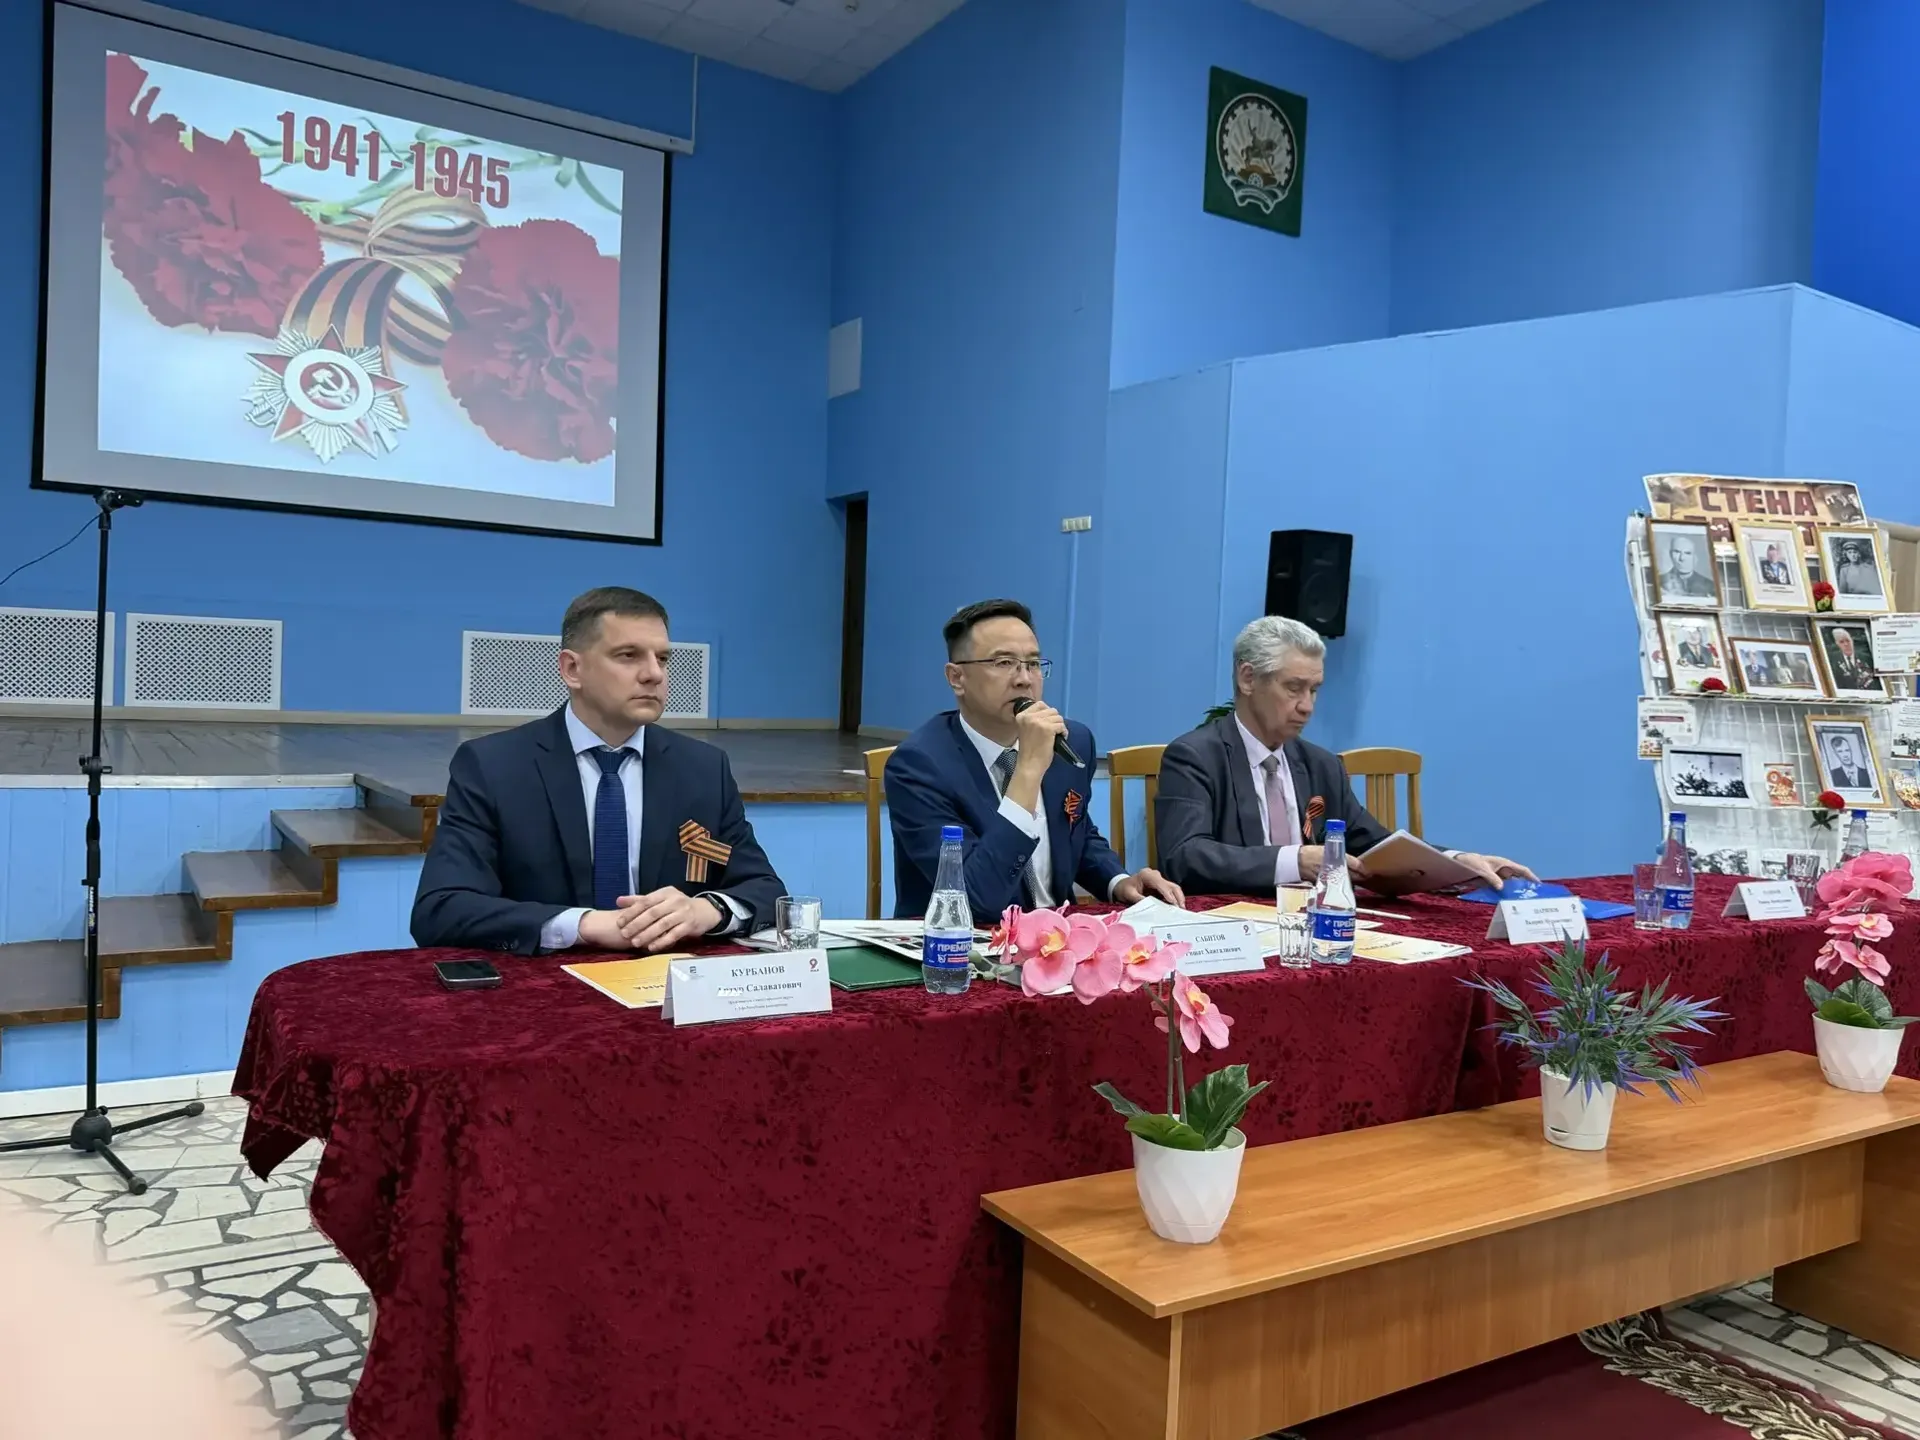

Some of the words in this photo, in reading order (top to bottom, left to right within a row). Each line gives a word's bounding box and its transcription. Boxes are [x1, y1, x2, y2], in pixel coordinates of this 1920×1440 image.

[276, 110, 511, 209] 1941-1945
[1698, 486, 1818, 517] СТЕНА
[1195, 933, 1227, 943] САБИТОВ
[731, 965, 786, 977] КУРБАНОВ
[745, 981, 803, 993] Салаватович
